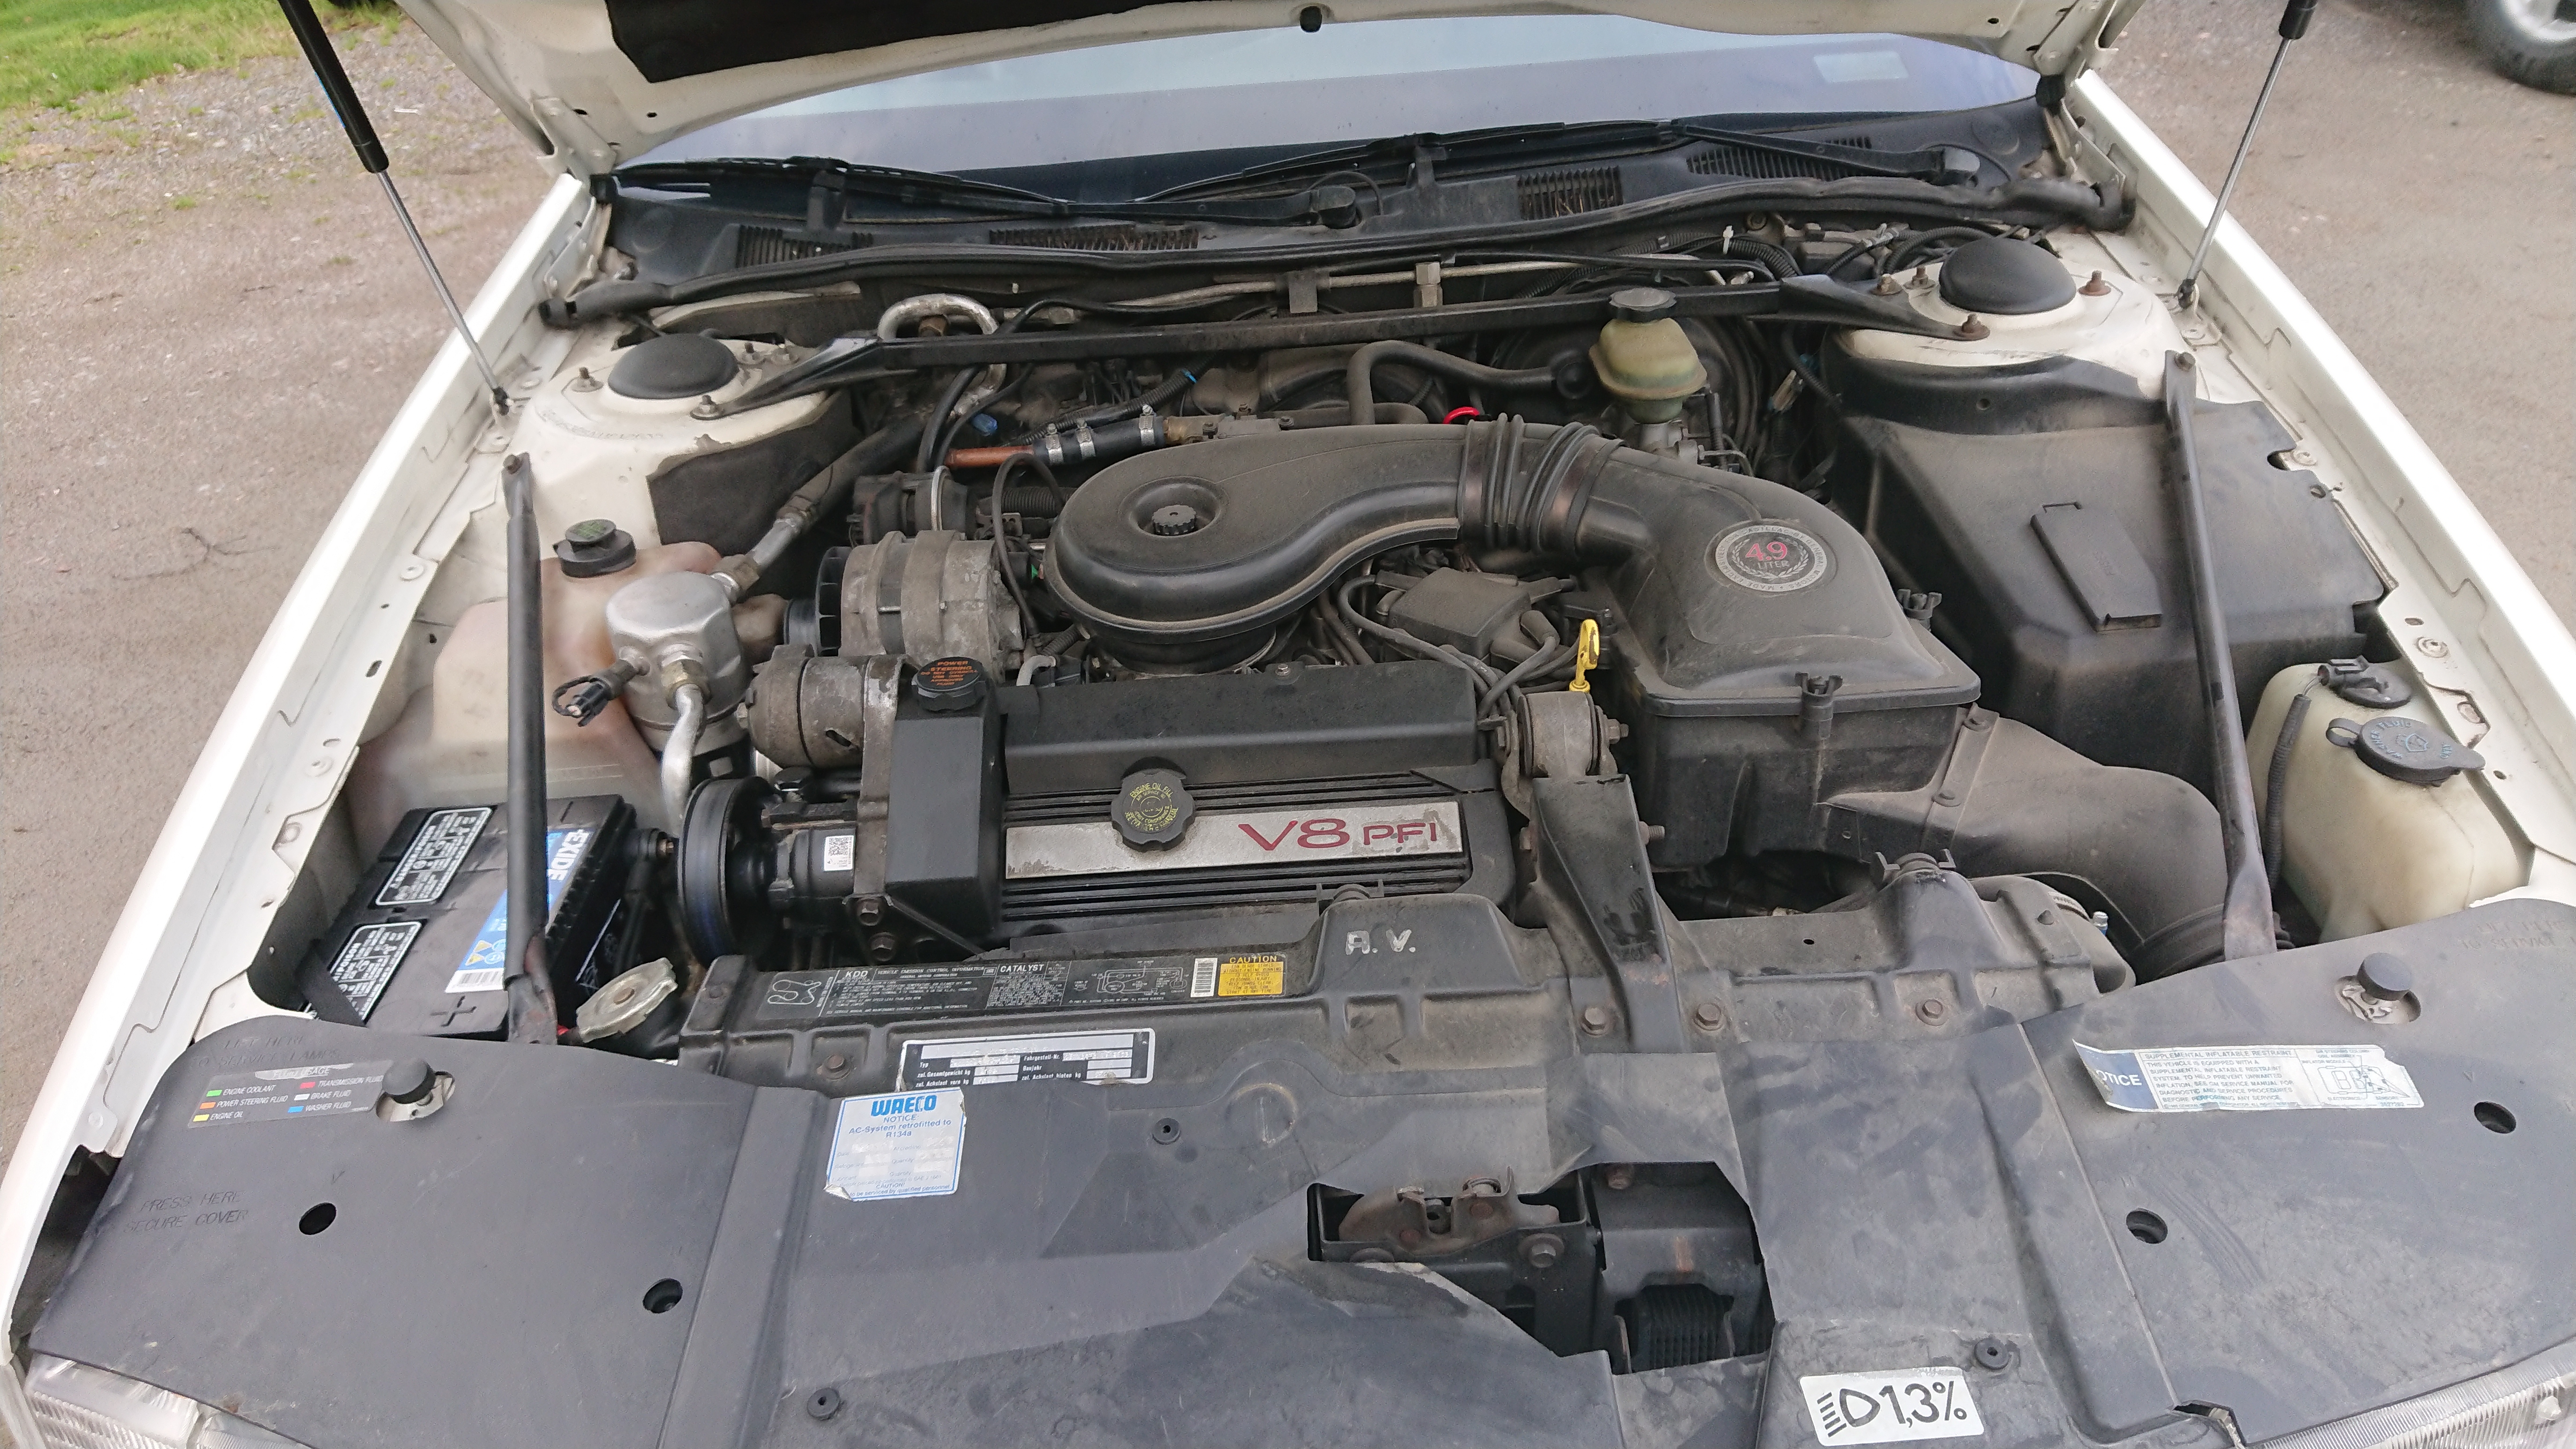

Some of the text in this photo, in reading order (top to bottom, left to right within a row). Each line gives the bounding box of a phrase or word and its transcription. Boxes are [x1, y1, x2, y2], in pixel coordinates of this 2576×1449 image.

[1741, 526, 1790, 534] CADILLAC
[1745, 541, 1788, 561] 4.9
[1758, 560, 1790, 570] LITER
[1129, 783, 1150, 798] ENGINE
[1163, 786, 1174, 798] FILL
[1238, 818, 1438, 851] V8 PFI
[547, 829, 590, 882] EXIDE
[1229, 955, 1277, 964] CAUTION
[1000, 964, 1044, 973] CATALYST
[300, 1068, 330, 1076] USAGE
[2096, 1069, 2142, 1086] OTICE
[318, 1077, 365, 1088] TRANSMISSION
[223, 1084, 277, 1096] ENGINE COOLANT
[310, 1090, 351, 1100] BRAKE FLUID
[239, 1097, 270, 1106] STEERING
[270, 1095, 289, 1103] FLUID
[871, 1095, 937, 1117] WAECO
[305, 1103, 333, 1112] WASHER
[210, 1111, 234, 1120] ENGINE
[849, 1124, 896, 1134] AC-System
[899, 1120, 941, 1129] retrofitted
[140, 1190, 245, 1212] PRESS HERE
[124, 1215, 187, 1233] SECURE
[195, 1209, 249, 1226] COVER
[1879, 1381, 1968, 1428] 1,3%
